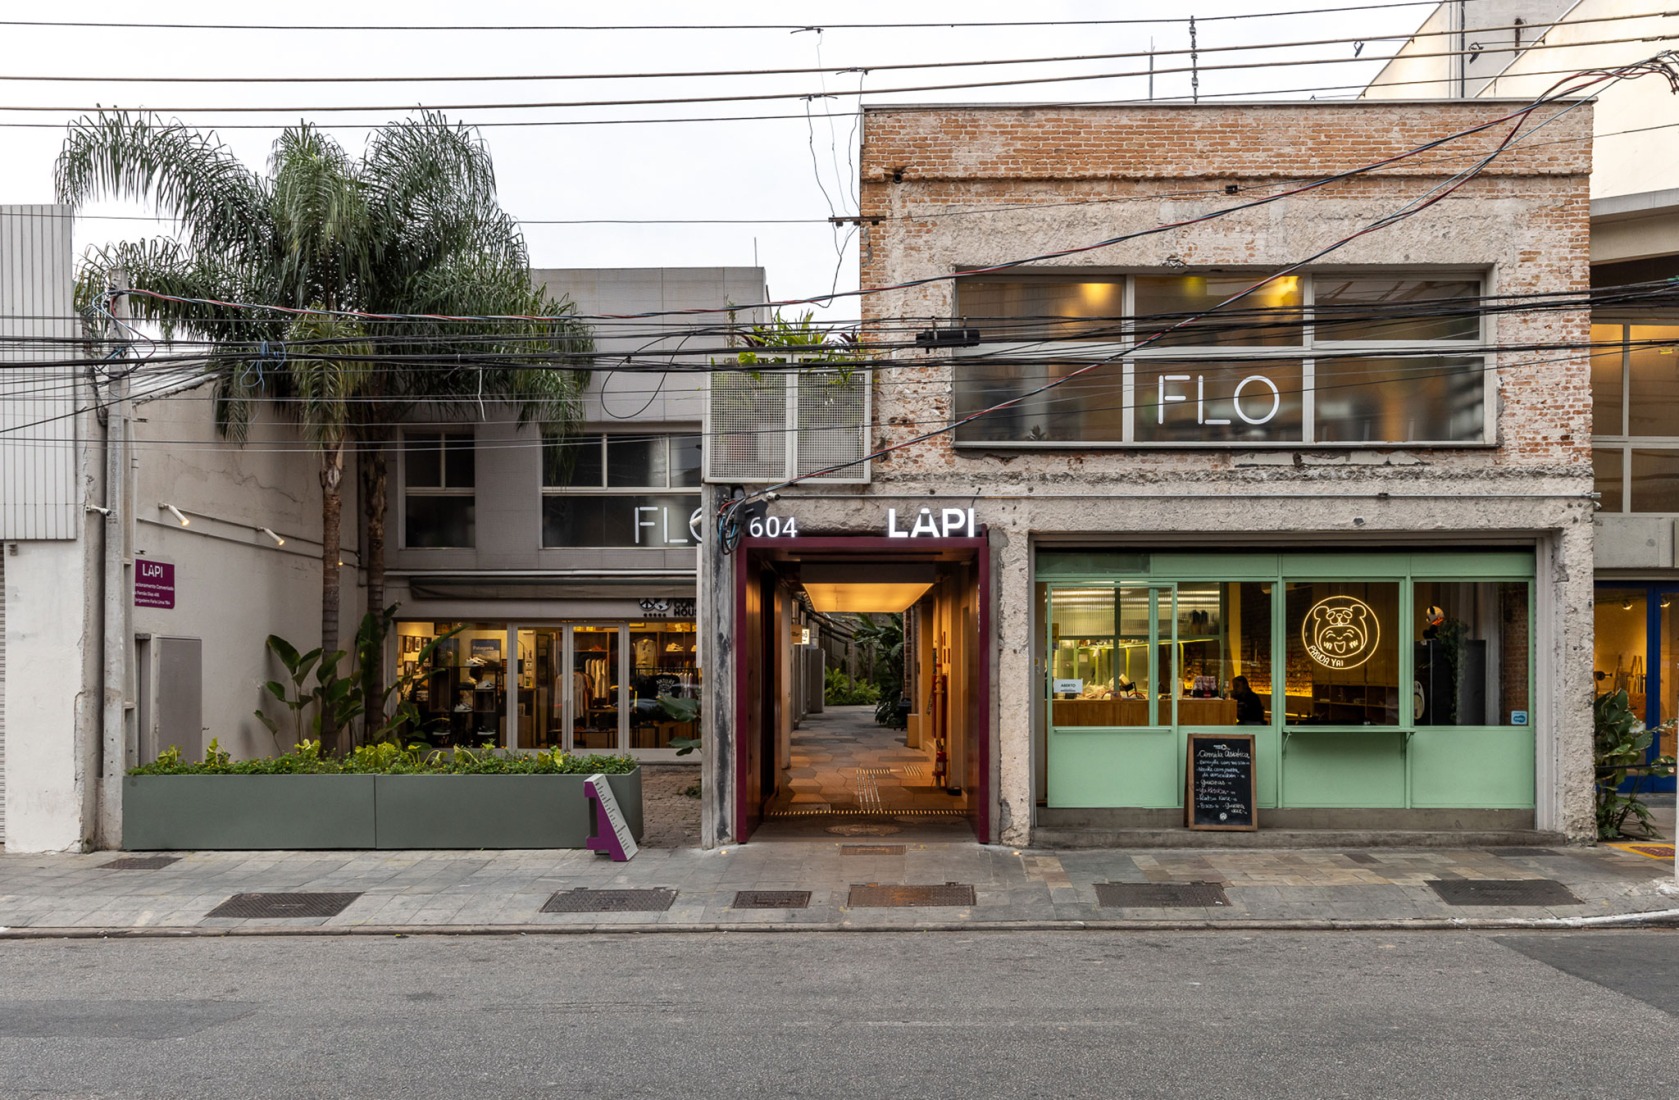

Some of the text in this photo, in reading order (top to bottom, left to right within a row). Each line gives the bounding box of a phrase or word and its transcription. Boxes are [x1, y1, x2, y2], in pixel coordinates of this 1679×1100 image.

[1158, 375, 1280, 425] FLO
[749, 516, 798, 538] 604
[888, 508, 975, 538] LAPI
[142, 563, 164, 578] LAPI
[1308, 645, 1344, 667] PANDA YAI
